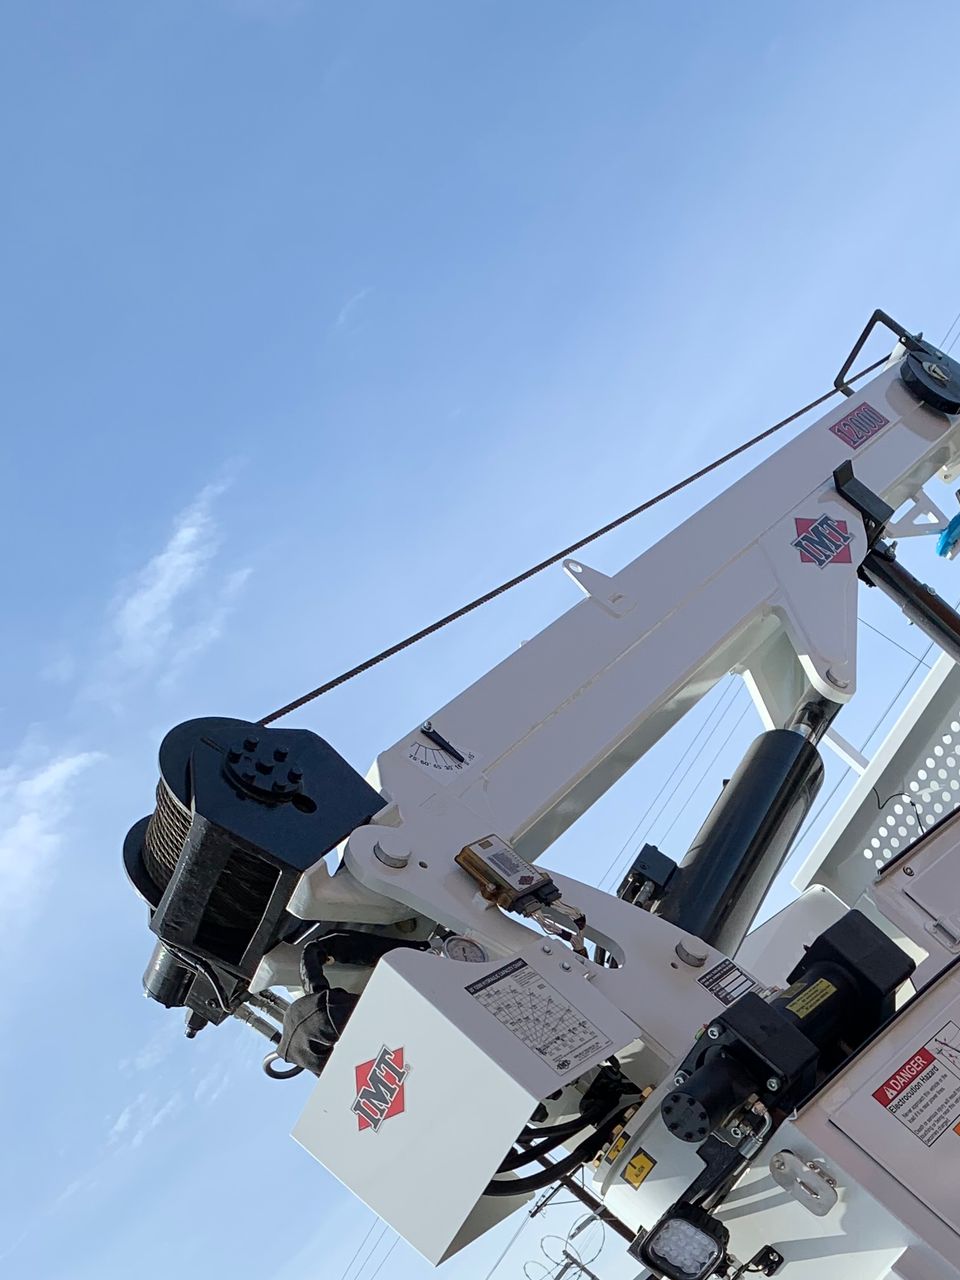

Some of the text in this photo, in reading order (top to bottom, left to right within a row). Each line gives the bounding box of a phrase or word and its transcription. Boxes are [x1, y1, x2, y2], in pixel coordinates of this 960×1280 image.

[833, 405, 885, 447] 12000
[790, 514, 853, 568] IMT
[350, 1045, 408, 1132] IMT
[887, 1063, 939, 1114] Electrocution Hazard
[890, 1054, 928, 1089] DANGER
